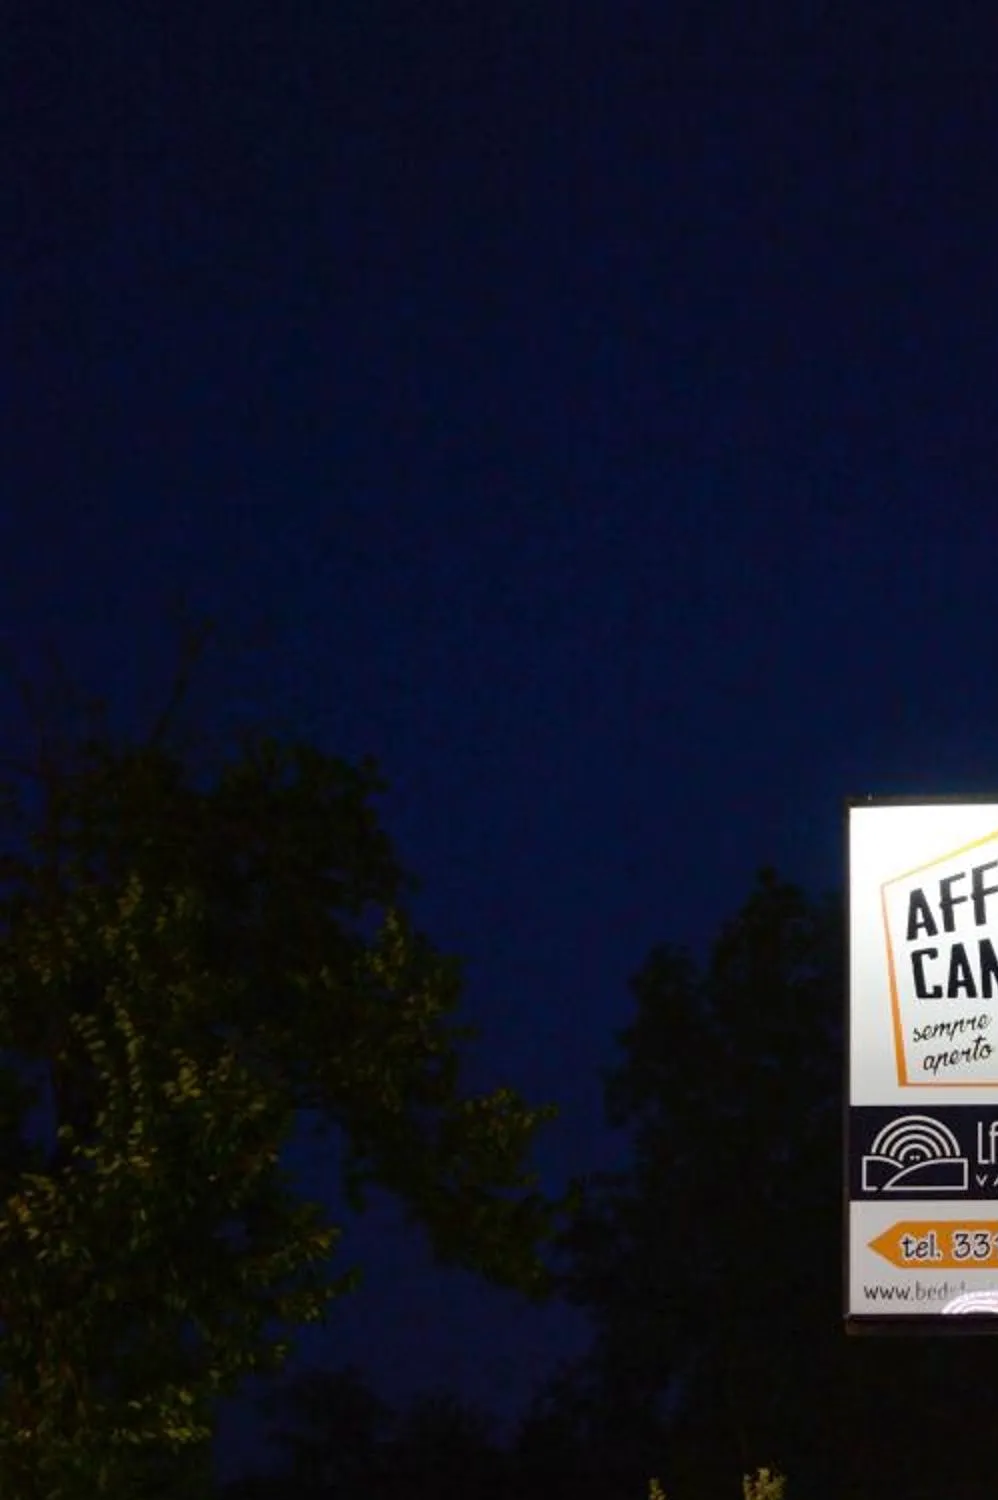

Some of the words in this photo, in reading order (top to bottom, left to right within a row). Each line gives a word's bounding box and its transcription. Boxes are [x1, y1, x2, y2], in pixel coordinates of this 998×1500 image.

[912, 1012, 993, 1043] sempre
[922, 1035, 993, 1076] aperto
[902, 1232, 941, 1258] tel.
